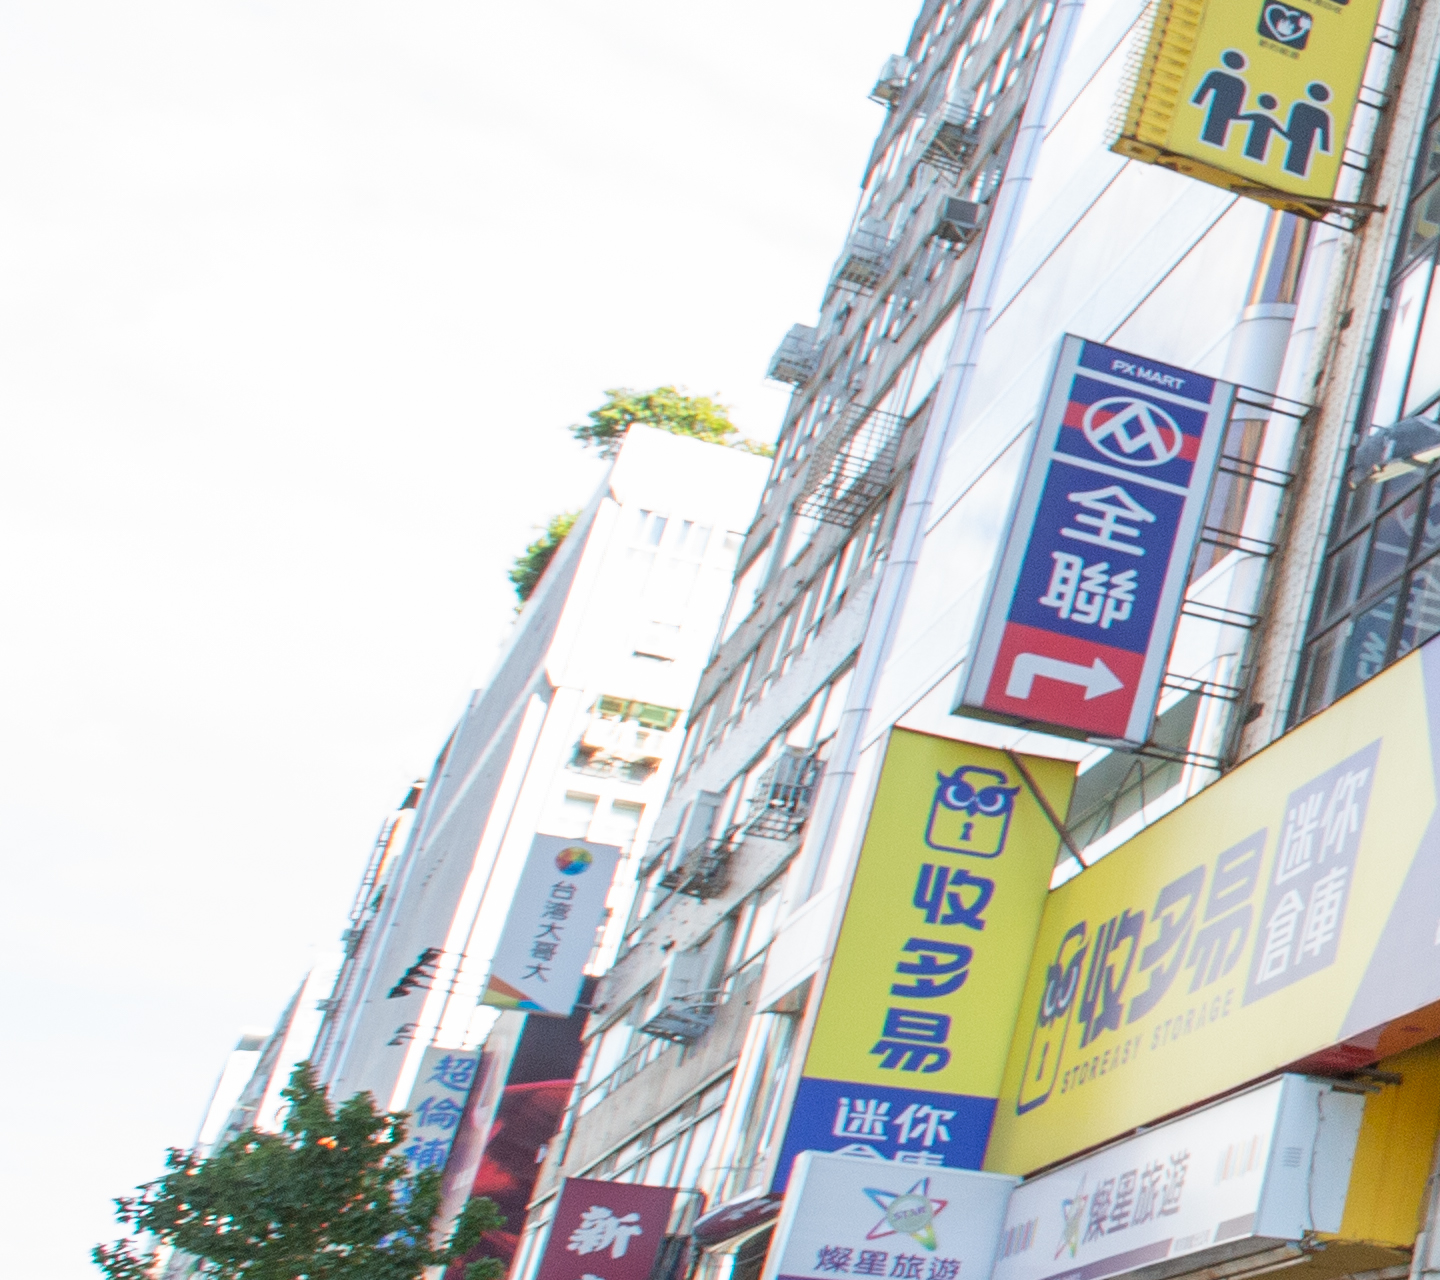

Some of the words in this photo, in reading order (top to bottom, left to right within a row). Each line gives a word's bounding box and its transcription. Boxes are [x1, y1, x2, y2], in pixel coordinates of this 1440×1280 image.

[1112, 359, 1136, 376] PX
[1137, 367, 1185, 390] MART
[1038, 485, 1157, 629] 全聯
[1275, 766, 1370, 886] 迷你
[521, 880, 578, 982] 台灣大哥大
[869, 863, 995, 1074] 收多易
[1079, 827, 1267, 1048] 收多易
[1255, 865, 1347, 985] 倉庫
[1061, 1033, 1143, 1094] STOREASY
[1150, 989, 1235, 1051] STORAGE
[832, 1096, 957, 1147] 迷你
